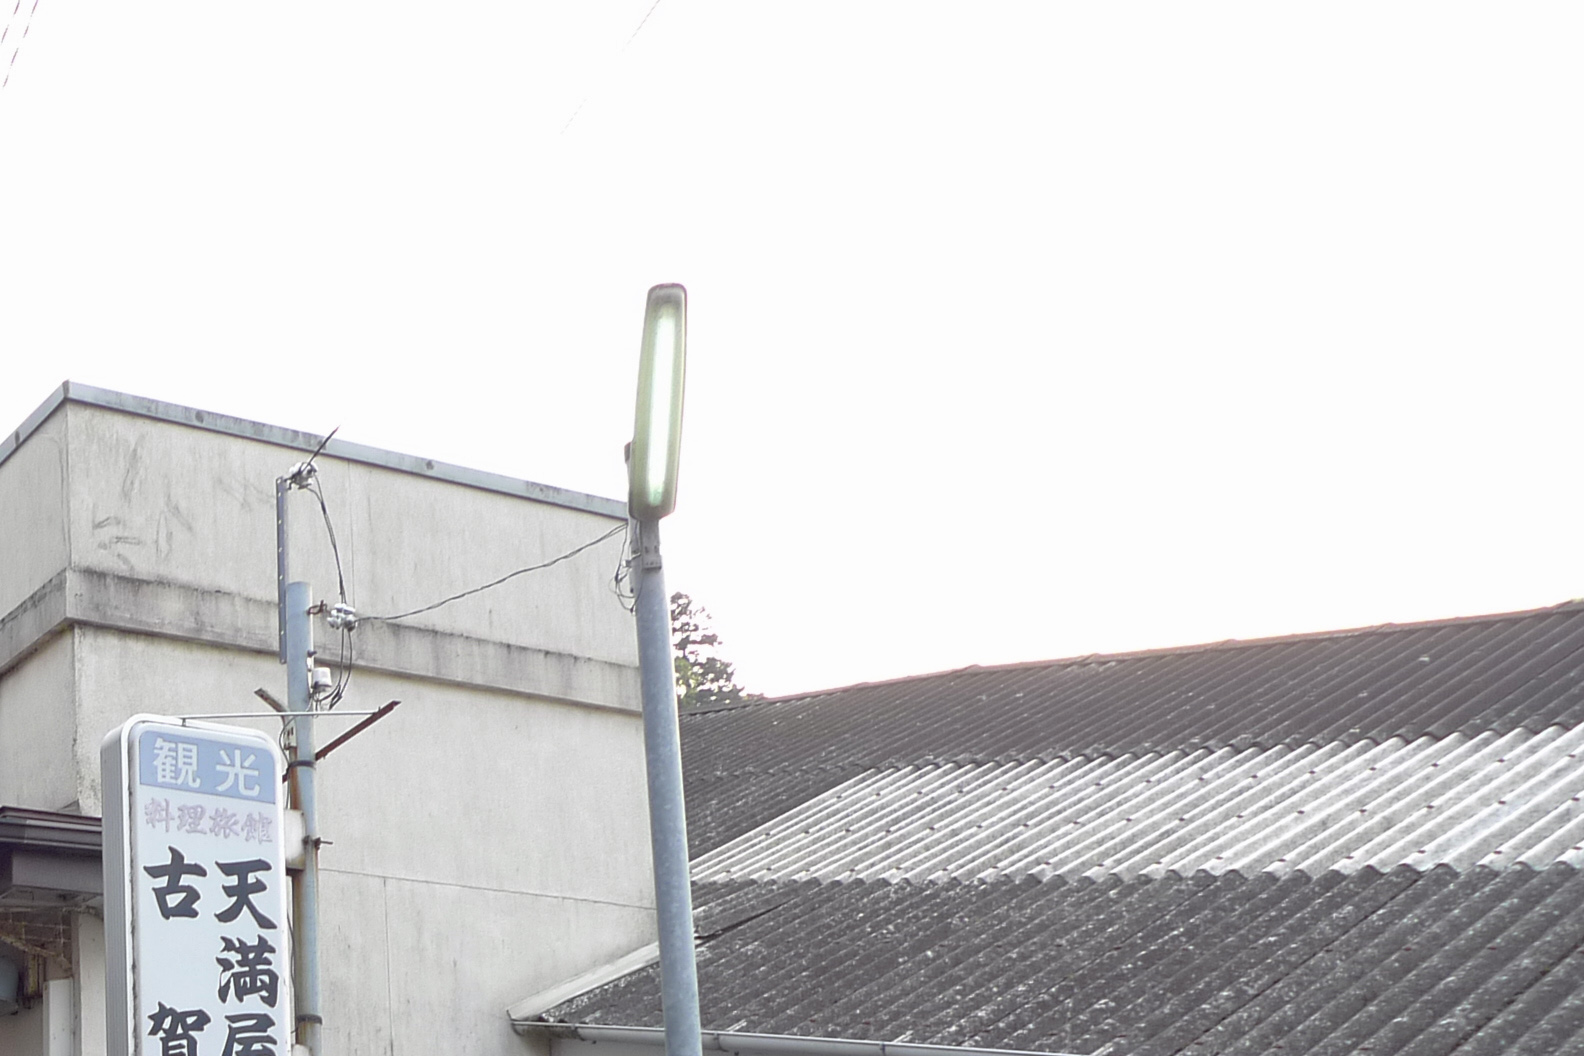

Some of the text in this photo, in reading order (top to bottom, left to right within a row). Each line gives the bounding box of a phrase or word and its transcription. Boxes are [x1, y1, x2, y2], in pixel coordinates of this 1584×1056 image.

[153, 738, 261, 797] 観光
[145, 798, 273, 845] 料理旅館
